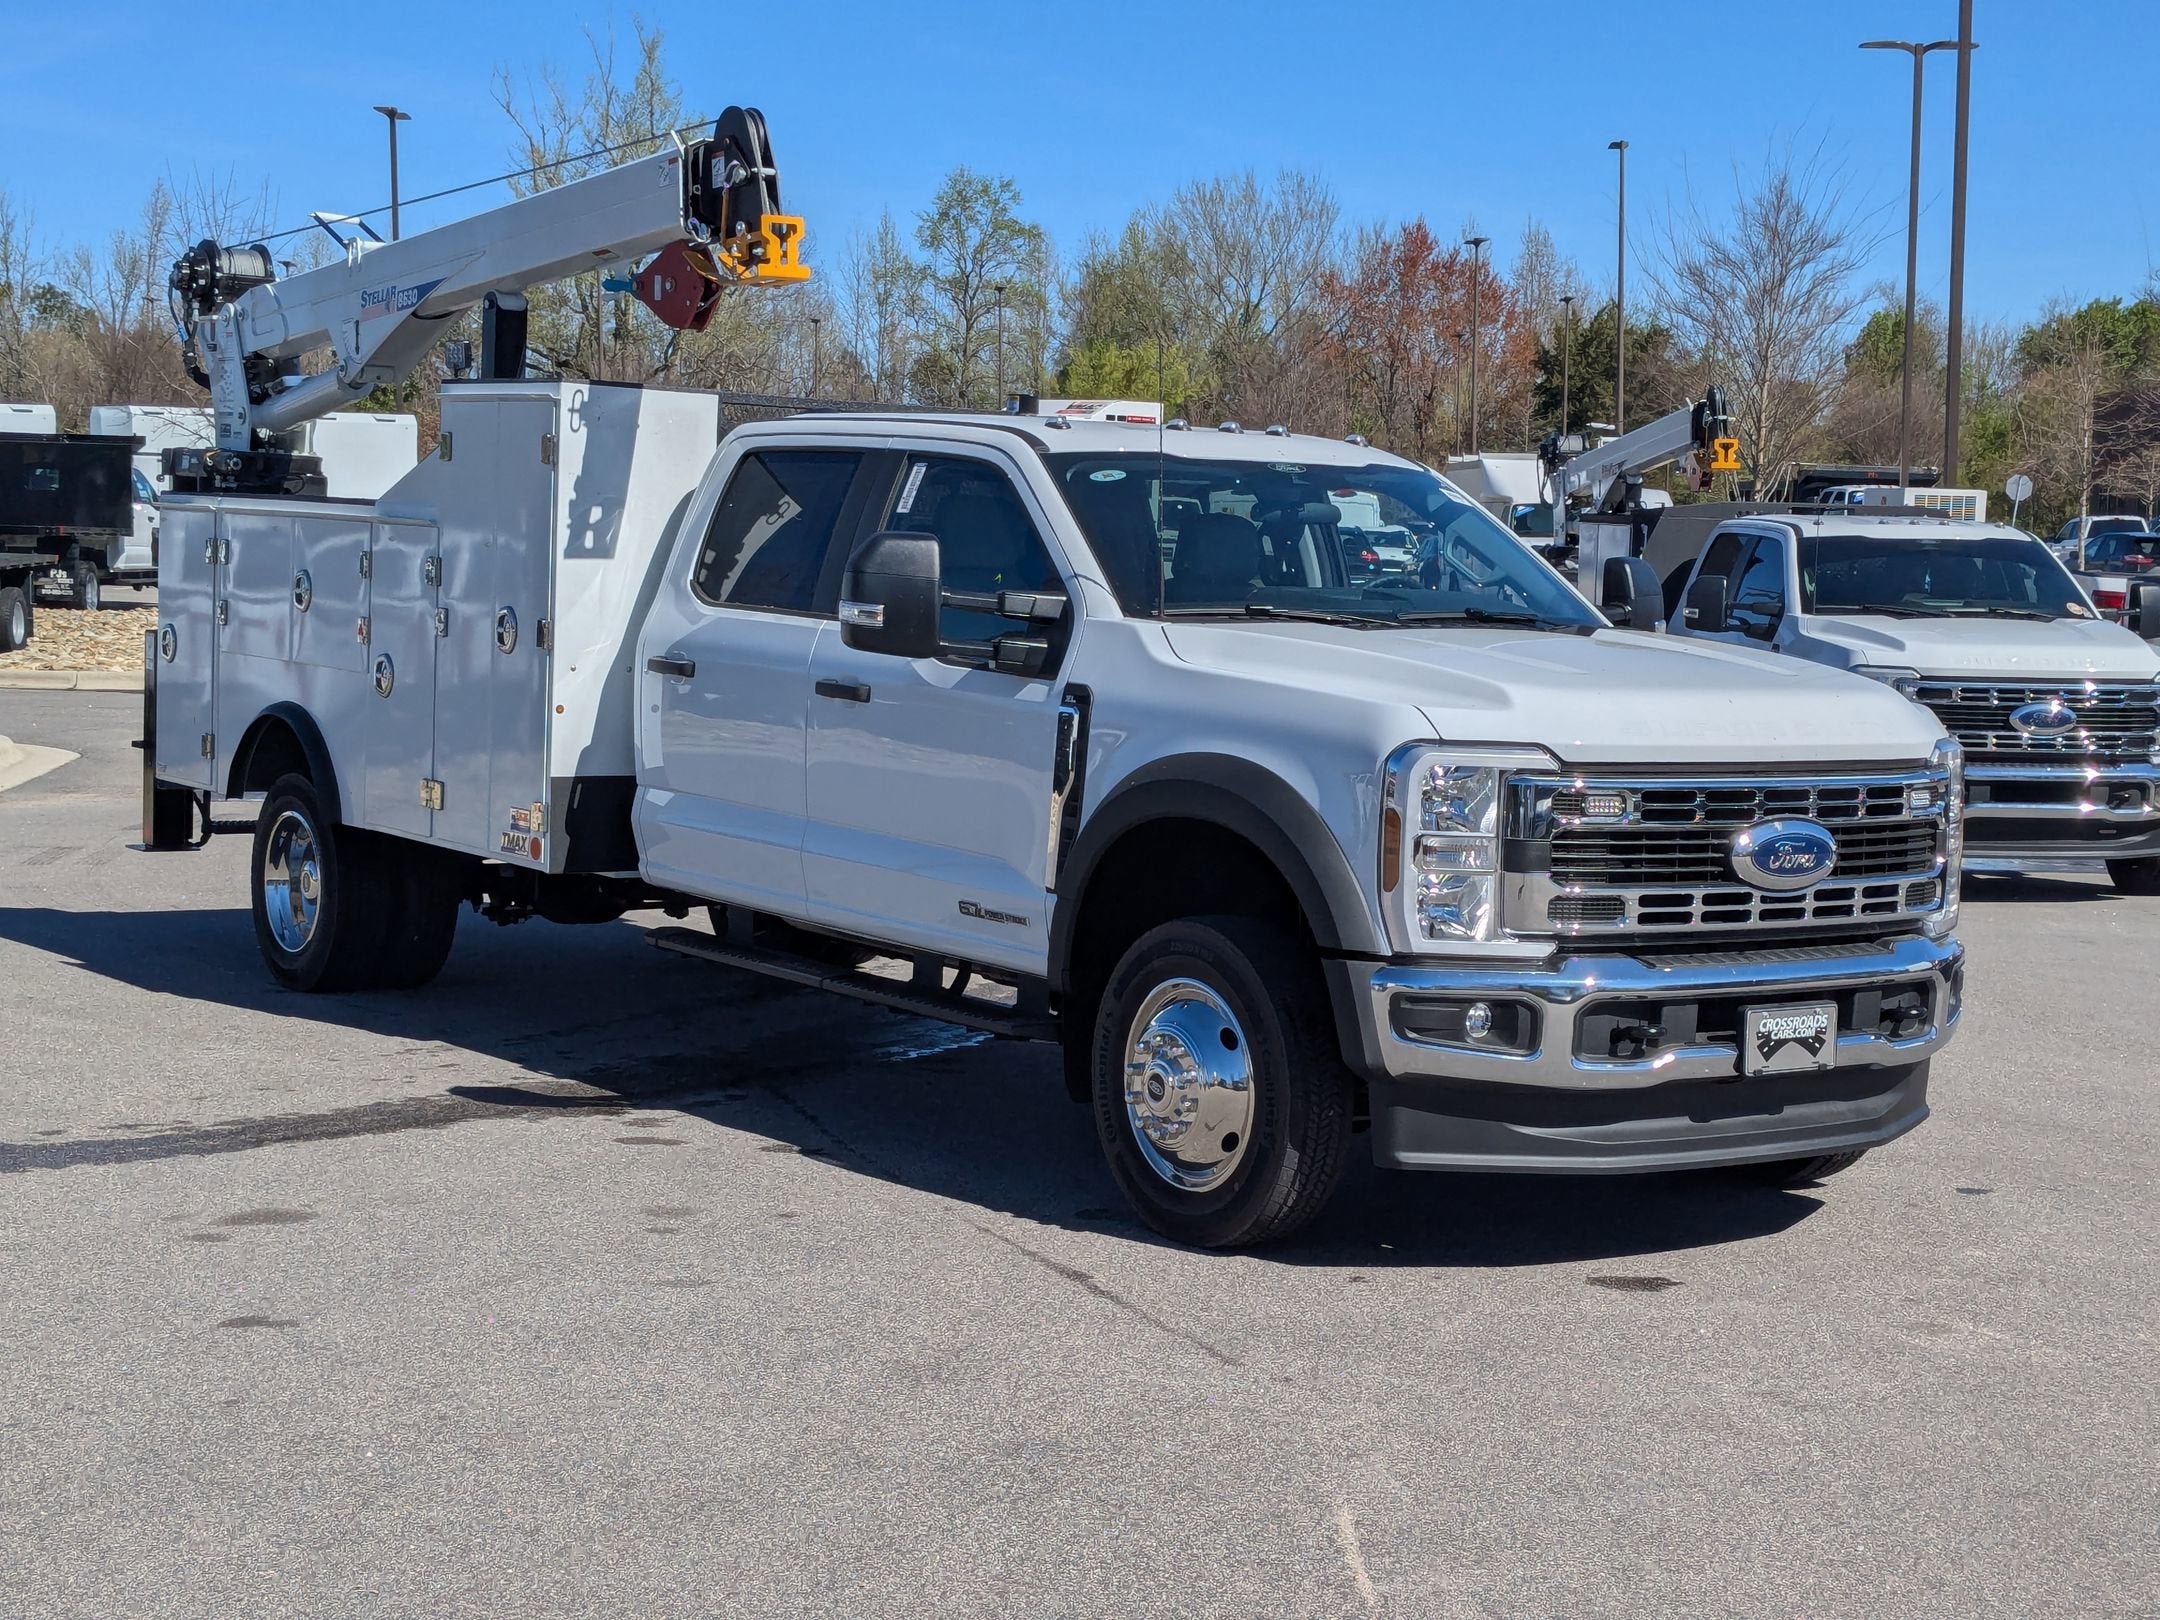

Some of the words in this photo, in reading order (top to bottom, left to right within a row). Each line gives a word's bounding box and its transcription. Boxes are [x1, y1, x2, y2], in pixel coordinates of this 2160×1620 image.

[361, 285, 397, 308] STELLAR
[502, 832, 528, 852] TMAX
[1769, 841, 1818, 869] Ford
[1759, 1014, 1829, 1032] CROSSROADS
[1771, 1027, 1816, 1040] CARS.COM
